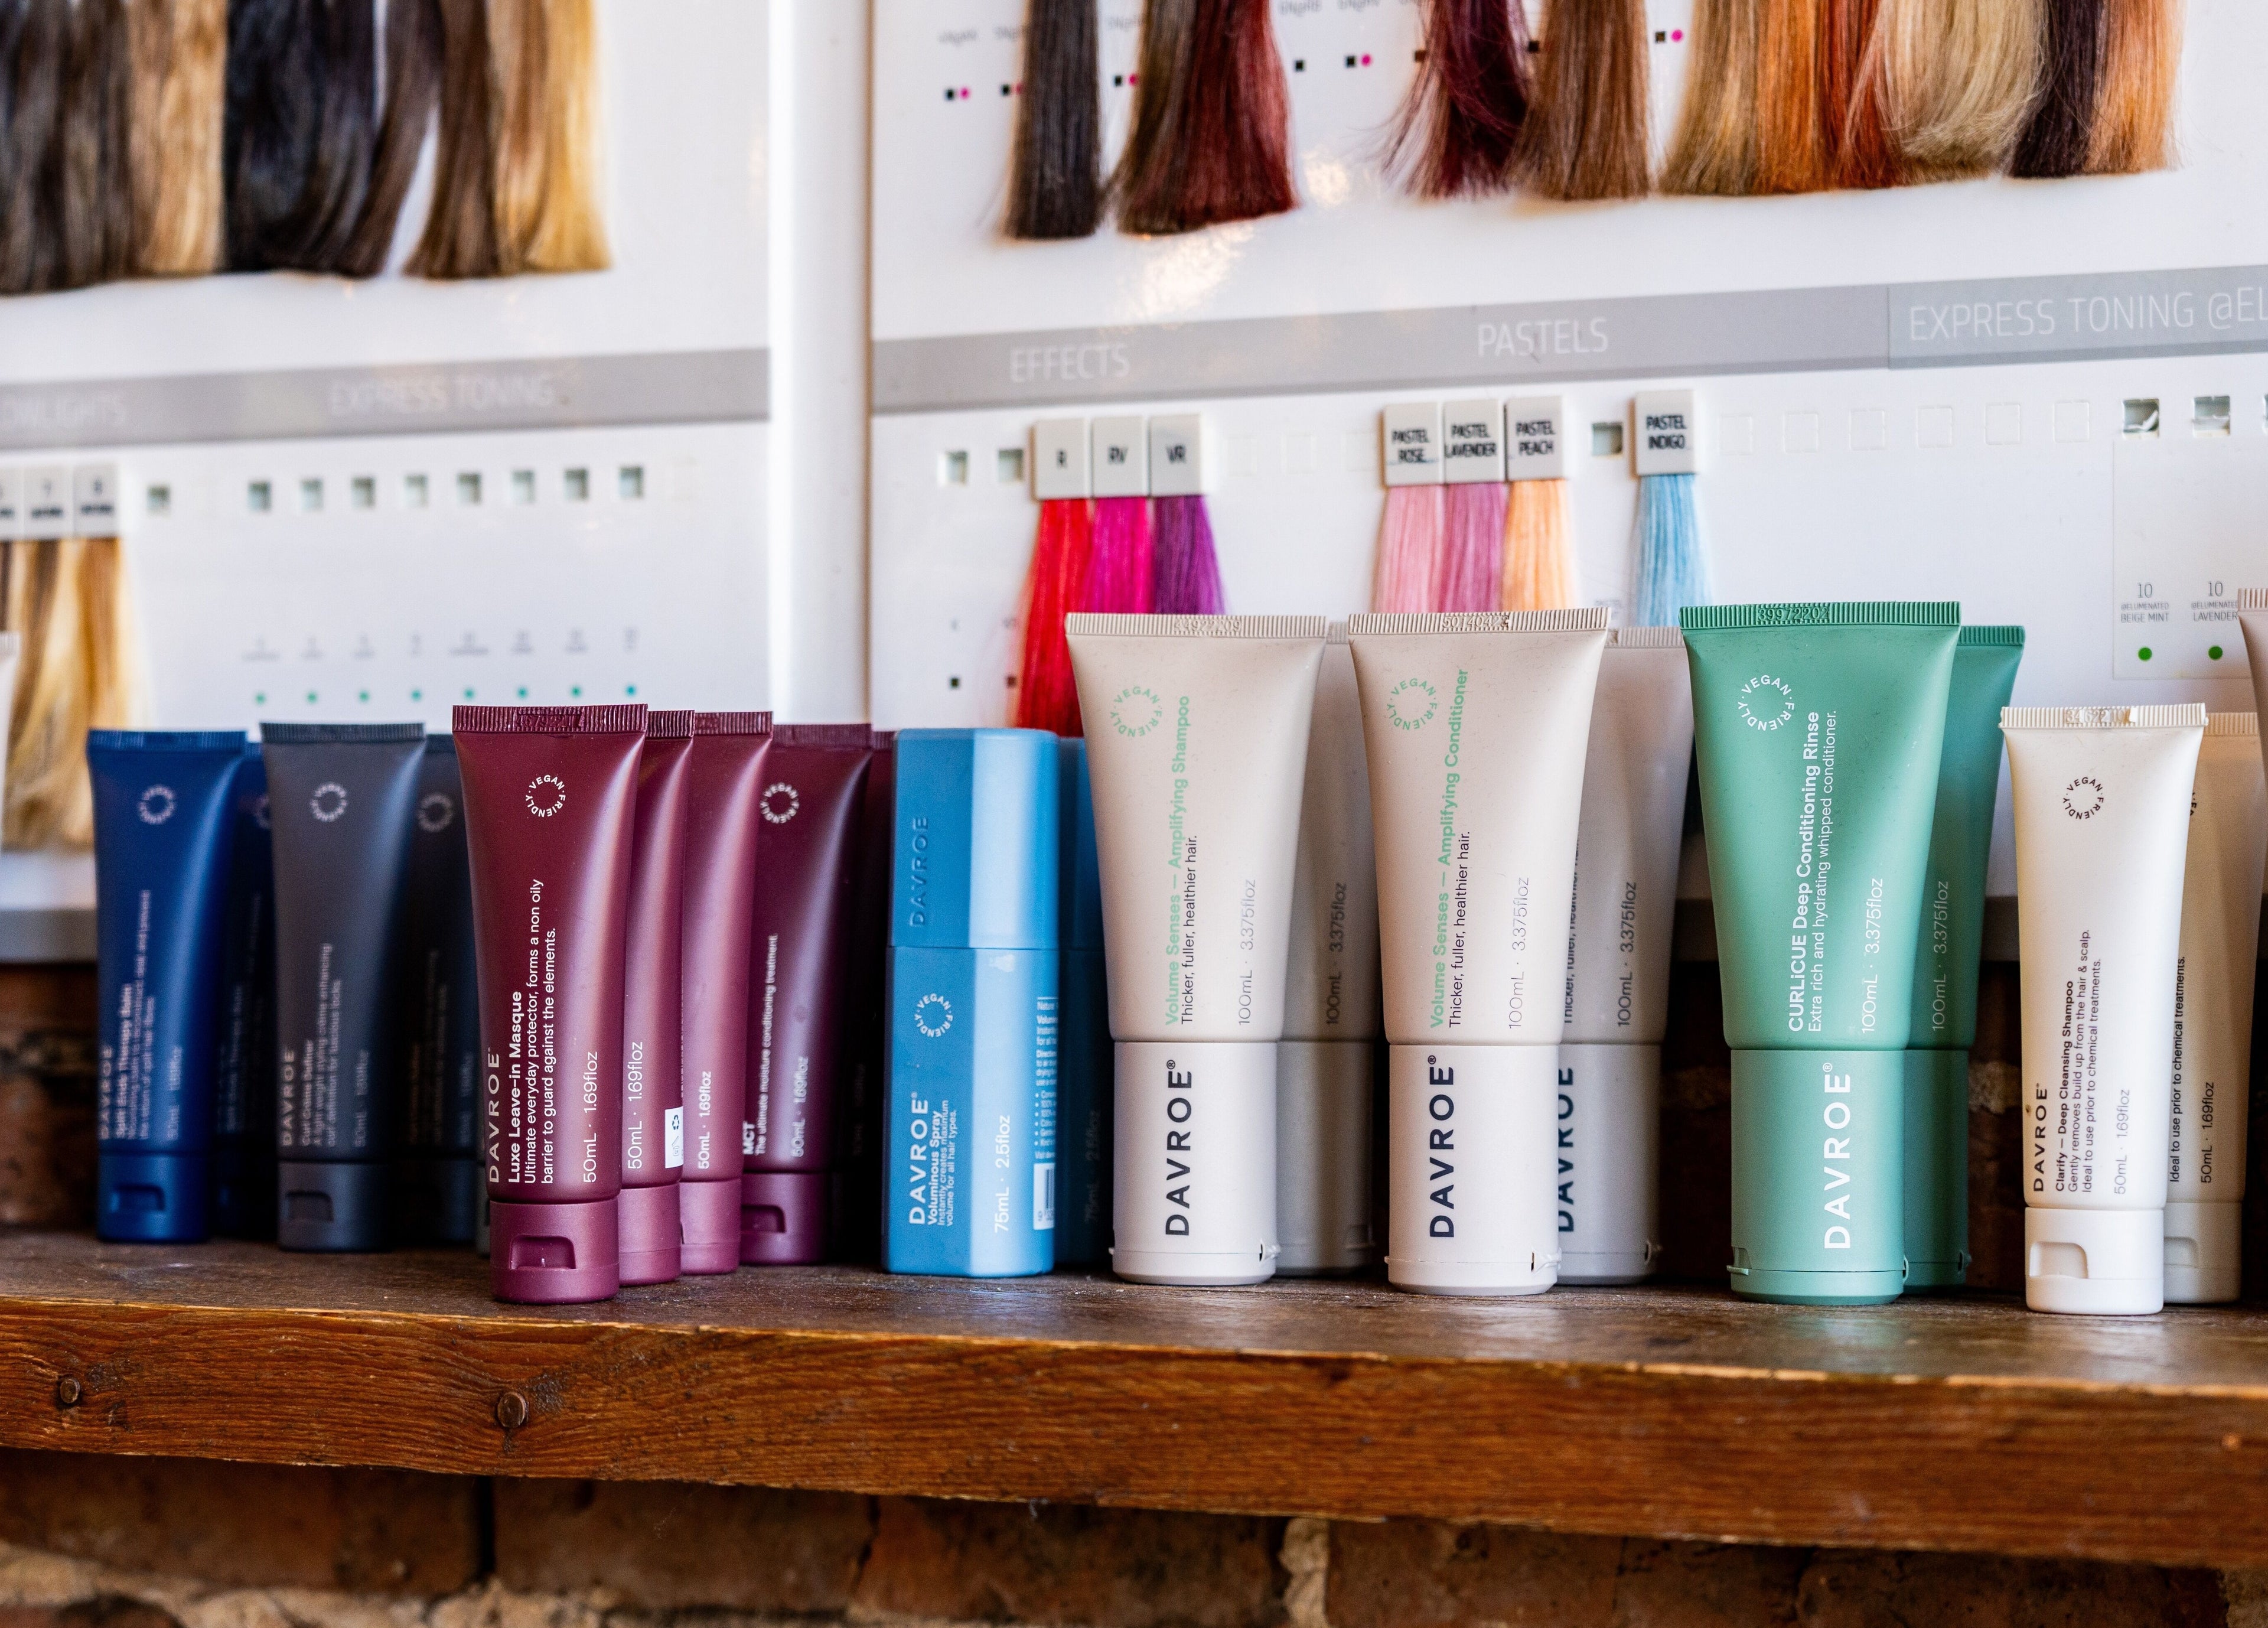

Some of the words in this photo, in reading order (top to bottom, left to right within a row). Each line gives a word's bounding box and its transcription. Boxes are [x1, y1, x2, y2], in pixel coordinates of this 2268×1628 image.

[1910, 299, 2055, 341] EXPRESS
[2068, 292, 2194, 333] TONING
[1478, 318, 1608, 356] PASTELS
[1010, 344, 1130, 383] EFFECTS
[1392, 428, 1429, 445] PASTEL
[1451, 422, 1491, 440] PASTEL
[1516, 420, 1555, 438] PASTEL
[1646, 414, 1687, 431] PASTEL
[1648, 432, 1686, 450] INDIGO
[1445, 441, 1497, 458] LAVENDER
[2137, 582, 2153, 598] 10
[2208, 581, 2224, 597] 10
[2121, 613, 2145, 623] BEIGE
[2148, 613, 2169, 621] MINT
[2193, 611, 2238, 621] LAVENDER
[1113, 686, 1160, 704] VEGAN
[1391, 678, 1436, 696] VEGAN
[1741, 675, 1792, 696] VEGAN
[1110, 710, 1162, 737] FRIENDLY
[1171, 696, 1191, 773] Shampoo
[1387, 702, 1438, 731] FRIENDLY
[1444, 669, 1468, 767] Conditioner
[1738, 701, 1795, 731] FRIENDLY
[1803, 712, 1819, 760] Rinse
[1820, 710, 1837, 794] conditioner.
[529, 774, 565, 790] VEGAN
[2067, 777, 2103, 792] VEGAN
[525, 795, 566, 818] FRIENDLY
[1168, 778, 1189, 869] Amplifying
[1437, 772, 1460, 867] Amplifying
[1797, 765, 1821, 878] Conditioning
[2063, 797, 2104, 820] FRIENDLY
[1456, 831, 1471, 860] hair.
[1817, 797, 1833, 858] whipped
[1185, 835, 1198, 864] hair.
[529, 879, 543, 903] oily
[910, 816, 930, 927] DAVROE
[1183, 868, 1197, 927] healthier
[1239, 879, 1256, 950] 3.375floz
[1453, 864, 1468, 927] healthier
[1511, 877, 1530, 952] 3.375floz
[1793, 883, 1811, 929] Deep
[1813, 862, 1831, 928] hydrating
[530, 907, 540, 933] non
[1166, 895, 1181, 956] Senses
[1433, 893, 1449, 956] Senses
[1865, 878, 1884, 954] 3.375floz
[1933, 880, 1948, 955] 3.375floz
[529, 937, 539, 945] a
[543, 928, 556, 993] elements.
[1182, 932, 1197, 968] fuller,
[1451, 931, 1467, 969] fuller,
[1811, 932, 1825, 959] and
[2078, 929, 2091, 962] scalp.
[526, 949, 539, 988] forms
[1788, 935, 1807, 1033] CURLiCUE
[1810, 963, 1824, 991] rich
[2075, 976, 2087, 998] hair
[2077, 965, 2087, 973] &
[543, 997, 554, 1020] the
[1165, 961, 1180, 1025] Volume
[1181, 972, 1195, 1024] Thicker,
[1239, 969, 1253, 1026] 100mL
[1325, 972, 1342, 1025] 100mL
[1430, 962, 1446, 1028] Volume
[1449, 973, 1465, 1028] Thicker,
[1508, 971, 1525, 1029] 100mL
[1617, 972, 1633, 1027] 100mL
[1862, 973, 1879, 1034] 100mL
[1932, 973, 1947, 1032] 100mL
[2061, 981, 2075, 1037] Shampoo
[2075, 1001, 2086, 1020] the
[2088, 959, 2101, 1023] treatments.
[510, 991, 525, 1059] Masque
[527, 991, 540, 1057] protector,
[1808, 995, 1823, 1033] Extra
[543, 1023, 556, 1073] against
[2073, 1023, 2084, 1050] from
[2086, 1025, 2098, 1077] chemical
[2172, 1021, 2184, 1070] chemical
[628, 1041, 643, 1102] 1.69floz
[755, 1135, 767, 1155] The
[761, 985, 777, 1048] conditioning
[2059, 1041, 2073, 1099] Cleansing
[2074, 1053, 2085, 1068] up
[2172, 1073, 2183, 1085] to
[509, 1064, 522, 1138] Leave-in
[526, 1063, 540, 1124] everyday
[542, 1077, 556, 1117] guard
[584, 1051, 598, 1113] 1.69floz
[2071, 1071, 2083, 1100] build
[2086, 1080, 2096, 1092] to
[2172, 1088, 2184, 1115] prior
[543, 1121, 554, 1135] to
[2058, 1103, 2070, 1134] Deep
[2071, 1103, 2081, 1151] removes
[2085, 1095, 2097, 1122] prior
[2172, 1118, 2182, 1138] use
[628, 1121, 643, 1170] 50mL
[743, 1121, 754, 1155] MCT
[930, 1111, 942, 1148] Spray
[2085, 1126, 2094, 1146] use
[2171, 1141, 2181, 1152] to
[509, 1144, 521, 1183] Luxe
[525, 1128, 537, 1184] Ultimate
[542, 1139, 554, 1184] barrier
[583, 1133, 597, 1183] 50mL
[698, 1132, 710, 1170] 50mL
[2083, 1150, 2093, 1162] to
[2169, 1155, 2181, 1183] Ideal
[2201, 1145, 2214, 1184] 50mL
[928, 1151, 939, 1225] Voluminous
[2055, 1152, 2067, 1192] Clarify
[2068, 1154, 2080, 1193] Gently
[2082, 1165, 2093, 1193] Ideal
[2114, 1155, 2127, 1195] 50mL
[938, 1185, 947, 1225] Instantly
[994, 1187, 1010, 1233] 75mL
